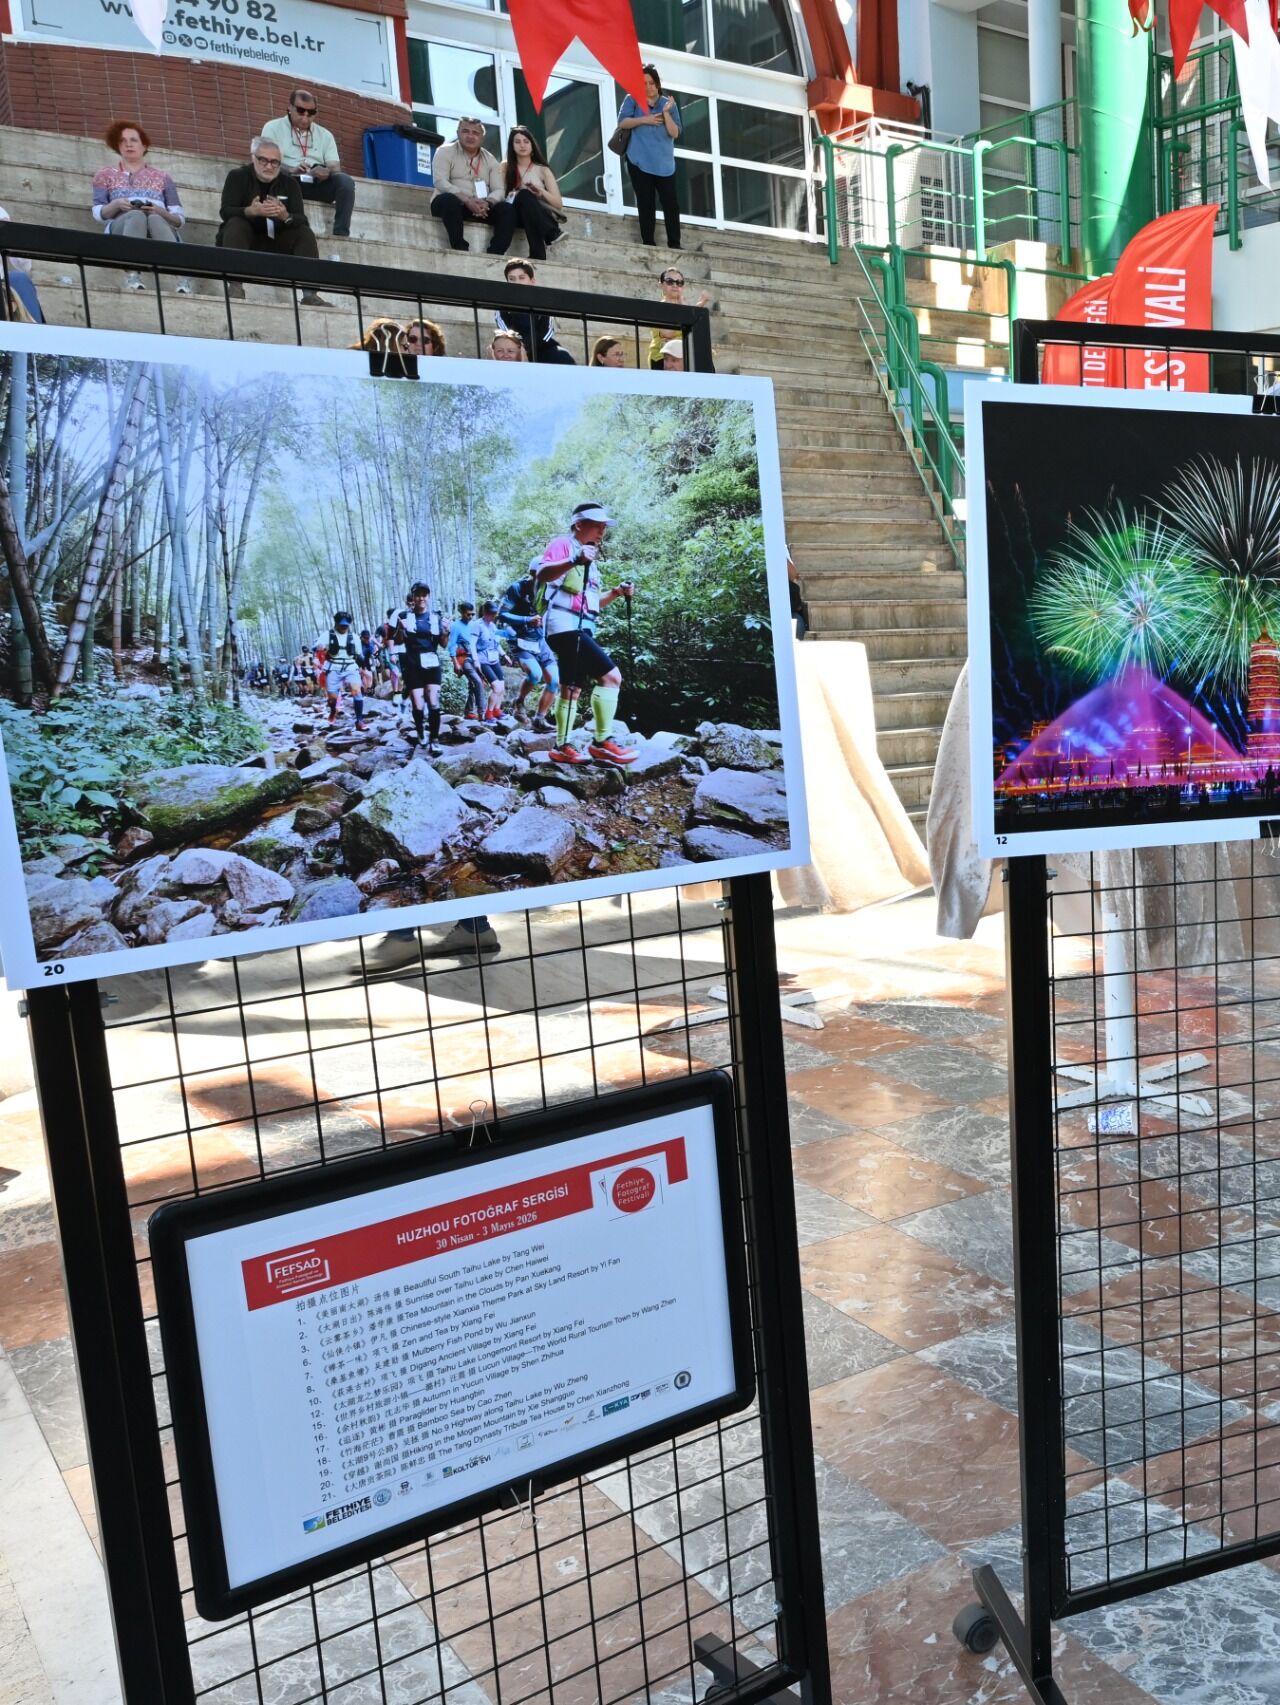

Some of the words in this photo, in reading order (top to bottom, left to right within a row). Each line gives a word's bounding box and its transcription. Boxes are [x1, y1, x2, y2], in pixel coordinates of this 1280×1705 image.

[101, 0, 325, 53] w.fethiye.bel.tr
[247, 1, 278, 22] 82
[210, 41, 290, 65] fethiyebelediye
[996, 836, 1007, 845] 12
[44, 964, 65, 976] 20
[396, 1219, 450, 1245] HUZHOU
[453, 1199, 519, 1228] FOTOĞRAF
[522, 1183, 569, 1208] SERGİSİ
[435, 1238, 448, 1250] 30
[450, 1231, 474, 1246] Nisan
[482, 1226, 488, 1236] 3
[491, 1220, 515, 1233] Mayıs
[516, 1211, 538, 1227] 2026
[274, 1257, 321, 1278] FEFSAD
[403, 1275, 436, 1293] Beautiful
[438, 1269, 460, 1282] South
[461, 1264, 481, 1274] Taihu
[482, 1257, 500, 1268] Lake
[501, 1254, 511, 1262] by
[511, 1248, 529, 1258] Tang
[530, 1243, 544, 1252] Wei
[404, 1291, 434, 1305] Sunrise
[435, 1285, 452, 1296] over
[453, 1279, 474, 1289] Taihu
[475, 1273, 493, 1284] Lake
[504, 1263, 524, 1273] Chen
[480, 1295, 506, 1307] Theme
[507, 1288, 524, 1299] Park
[525, 1285, 532, 1293] at
[533, 1281, 547, 1290] Sky
[548, 1274, 565, 1286] Land
[566, 1266, 589, 1280] Resort
[590, 1264, 598, 1272] by
[607, 1257, 620, 1266] Fan
[419, 1298, 455, 1314] Mountain
[464, 1292, 477, 1300] the
[478, 1282, 503, 1295] Clouds
[504, 1279, 513, 1288] by
[514, 1274, 529, 1283] Pan
[401, 1337, 417, 1347] Zen
[418, 1330, 433, 1342] and
[434, 1327, 448, 1336] Tea
[449, 1324, 459, 1332] by
[460, 1316, 482, 1328] Xiang
[483, 1312, 495, 1320] Fei
[411, 1342, 444, 1358] Mulberry
[446, 1335, 462, 1346] Fish
[463, 1327, 483, 1340] Pond
[484, 1325, 493, 1334] by
[494, 1321, 507, 1329] Wu
[437, 1347, 466, 1362] Ancient
[466, 1339, 491, 1352] Village
[492, 1335, 502, 1343] by
[503, 1328, 523, 1340] Xiang
[525, 1322, 536, 1332] Fei
[546, 1335, 566, 1348] World
[567, 1328, 586, 1340] Rural
[587, 1320, 613, 1333] Tourism
[613, 1313, 631, 1324] Town
[631, 1310, 640, 1318] by
[640, 1303, 659, 1314] Wang
[660, 1297, 676, 1308] Zhen
[435, 1364, 456, 1374] Taihu
[457, 1357, 476, 1368] Lake
[518, 1333, 541, 1346] Resort
[542, 1330, 551, 1339] by
[552, 1323, 572, 1335] Xiang
[573, 1318, 584, 1327] Fei
[422, 1389, 451, 1404] Autumn
[452, 1385, 459, 1393] in
[484, 1368, 509, 1381] Village
[510, 1365, 519, 1373] by
[520, 1357, 539, 1368] Shen
[416, 1413, 448, 1429] Bamboo
[449, 1407, 465, 1417] Sea
[466, 1403, 475, 1411] by
[476, 1397, 492, 1407] Cao
[493, 1390, 512, 1402] Zhen
[438, 1401, 448, 1410] by
[450, 1413, 482, 1429] Highway
[483, 1405, 503, 1417] along
[504, 1397, 523, 1408] Taihu
[525, 1391, 542, 1401] Lake
[543, 1386, 552, 1394] by
[553, 1382, 565, 1390] Wu
[566, 1373, 588, 1386] Zheng
[437, 1447, 452, 1456] The
[453, 1439, 472, 1450] Tang
[473, 1428, 502, 1443] Dynasty
[503, 1418, 527, 1432] Tribute
[528, 1413, 542, 1422] Tea
[543, 1404, 565, 1417] House
[566, 1400, 575, 1408] by
[576, 1393, 594, 1404] Chen
[442, 1434, 455, 1443] the
[482, 1411, 516, 1428] Mountain
[516, 1407, 525, 1416] by
[527, 1403, 539, 1412] Xie
